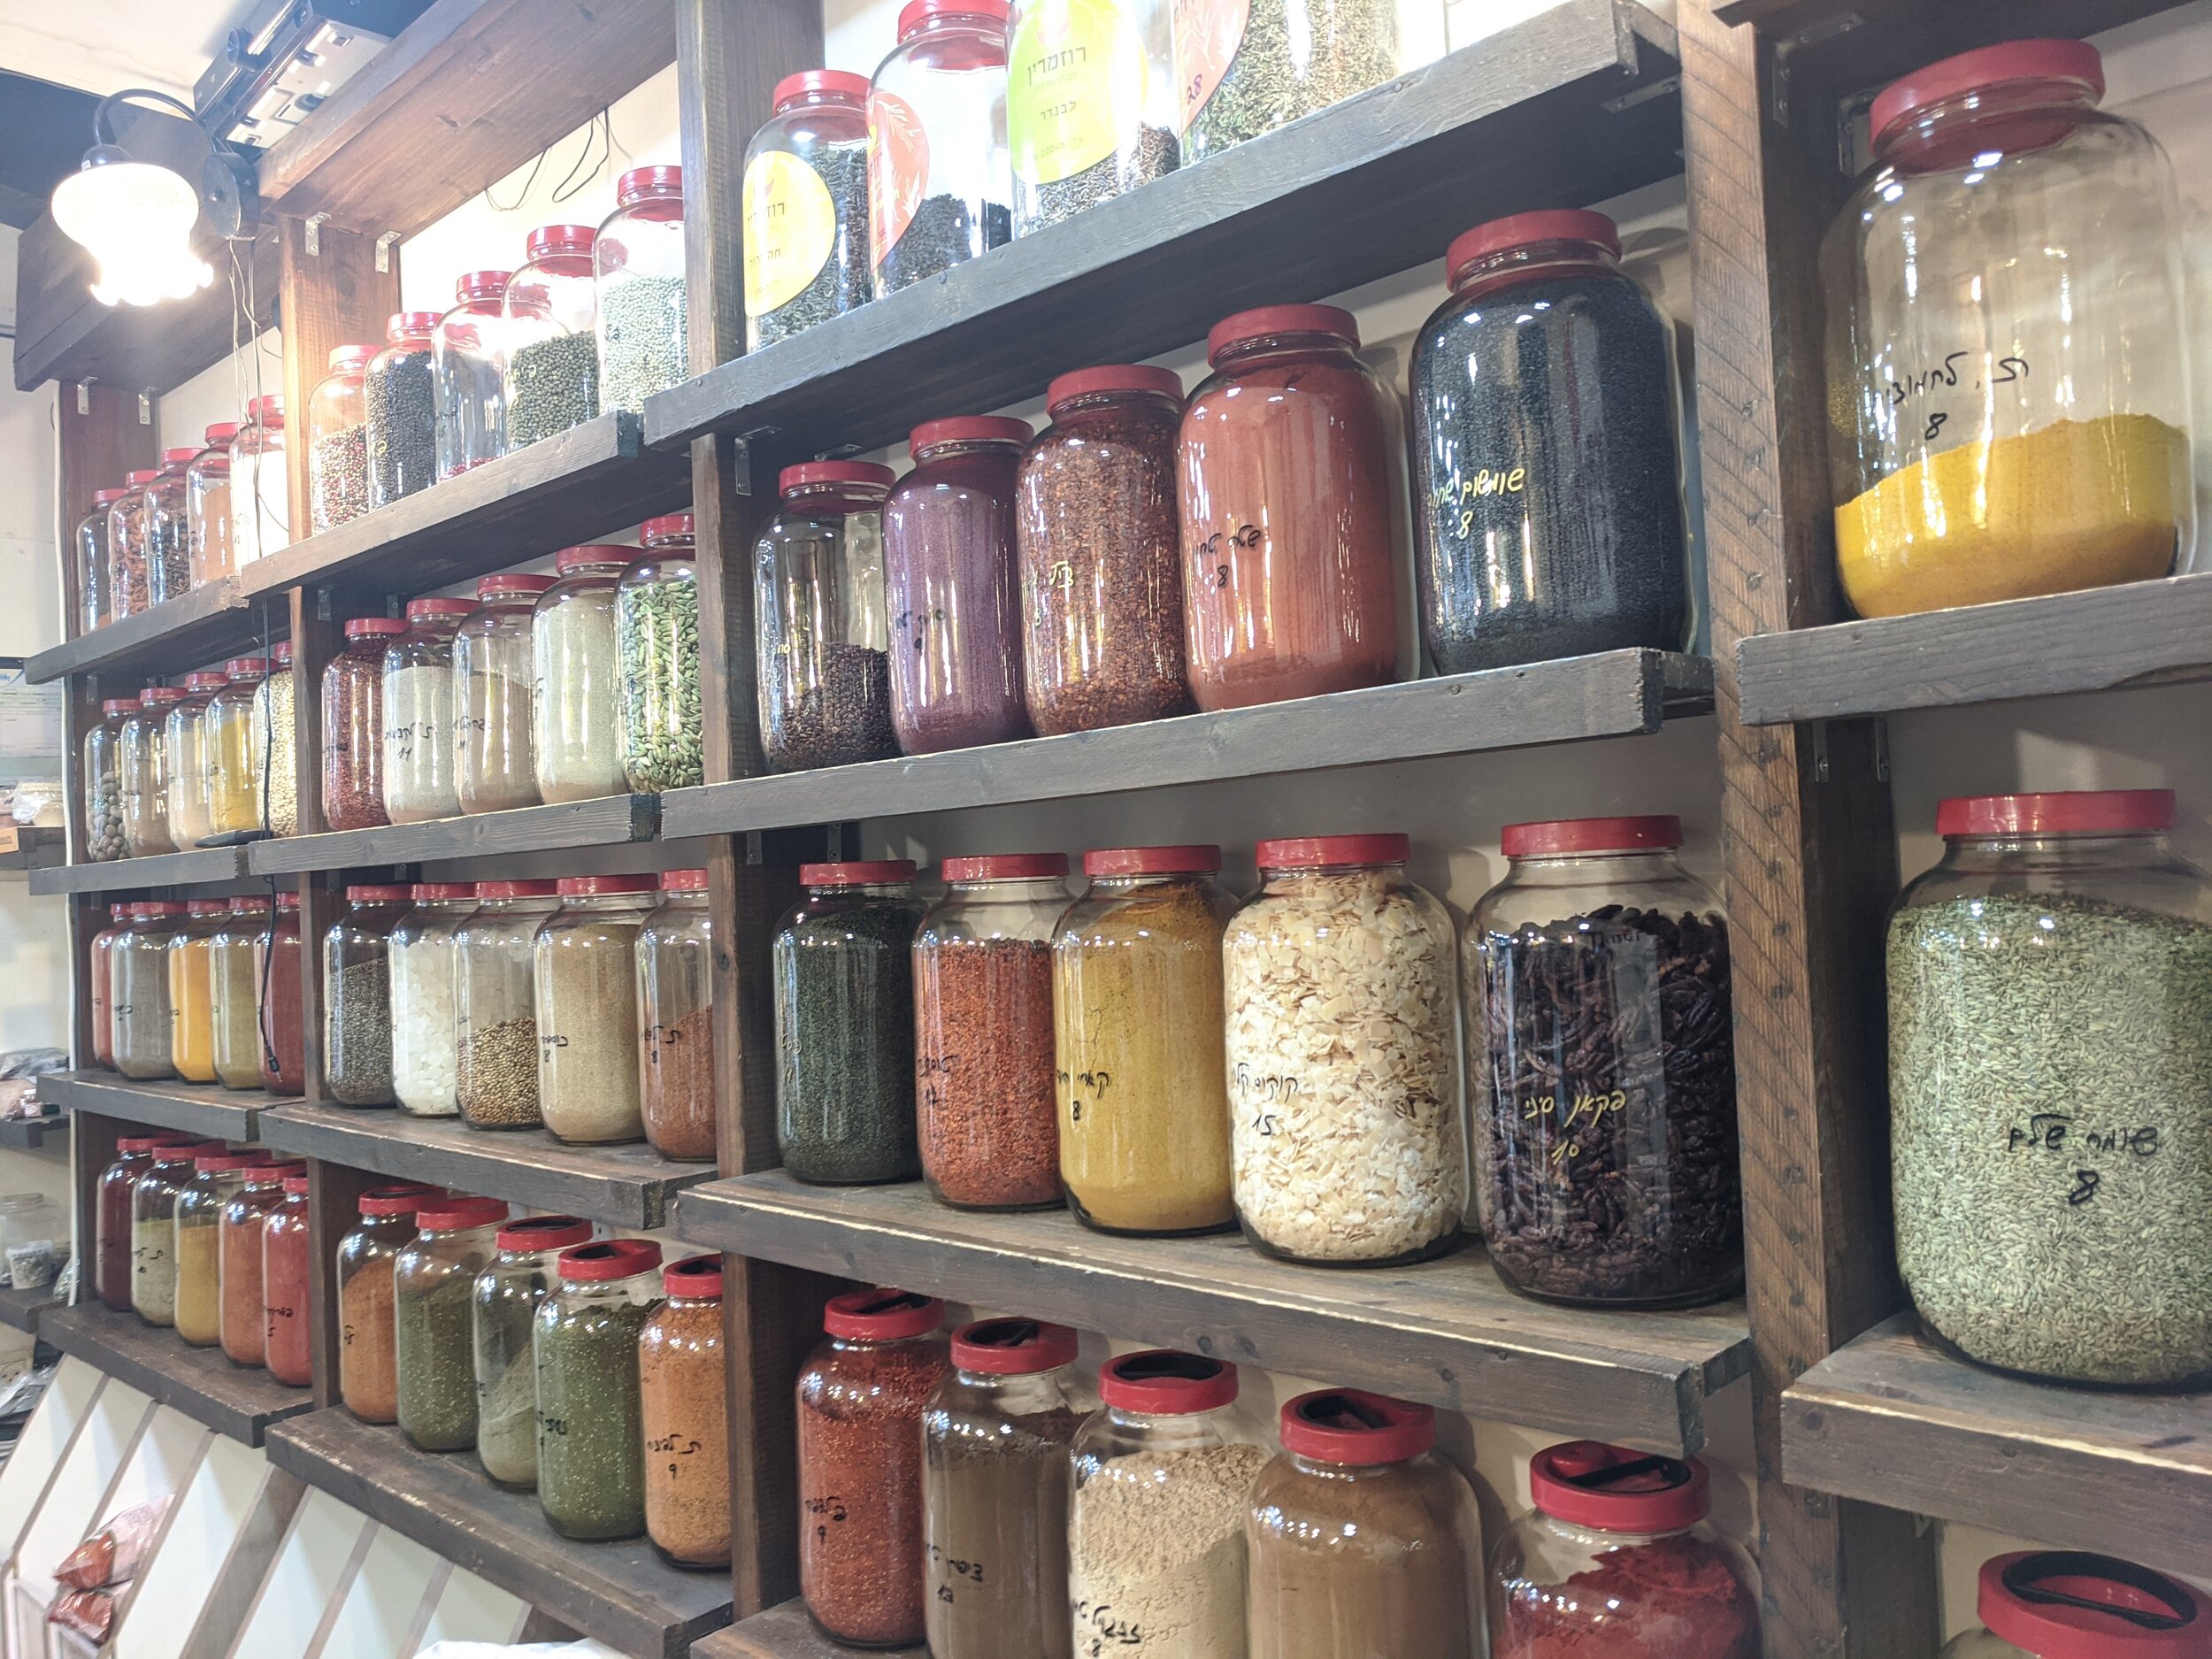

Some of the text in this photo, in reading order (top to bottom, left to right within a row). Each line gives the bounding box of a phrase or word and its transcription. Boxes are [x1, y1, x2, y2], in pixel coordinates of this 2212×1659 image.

[1027, 46, 1087, 86] רוזמרין
[1040, 100, 1077, 120] לבנדר
[747, 202, 785, 232] רוזרין
[1924, 411, 1948, 441] 8
[1457, 510, 1473, 540] 8
[1217, 565, 1229, 588] 8
[1077, 1070, 1110, 1099] קארי
[1254, 1074, 1299, 1104] קוקוס
[1072, 1100, 1081, 1121] 8
[1524, 1089, 1628, 1129] פקאן סיני
[1251, 1113, 1277, 1137] 15
[2008, 1112, 2159, 1157] שומר שלם
[1550, 1139, 1580, 1166] 10
[2068, 1168, 2101, 1206] 8
[668, 1463, 678, 1479] 9
